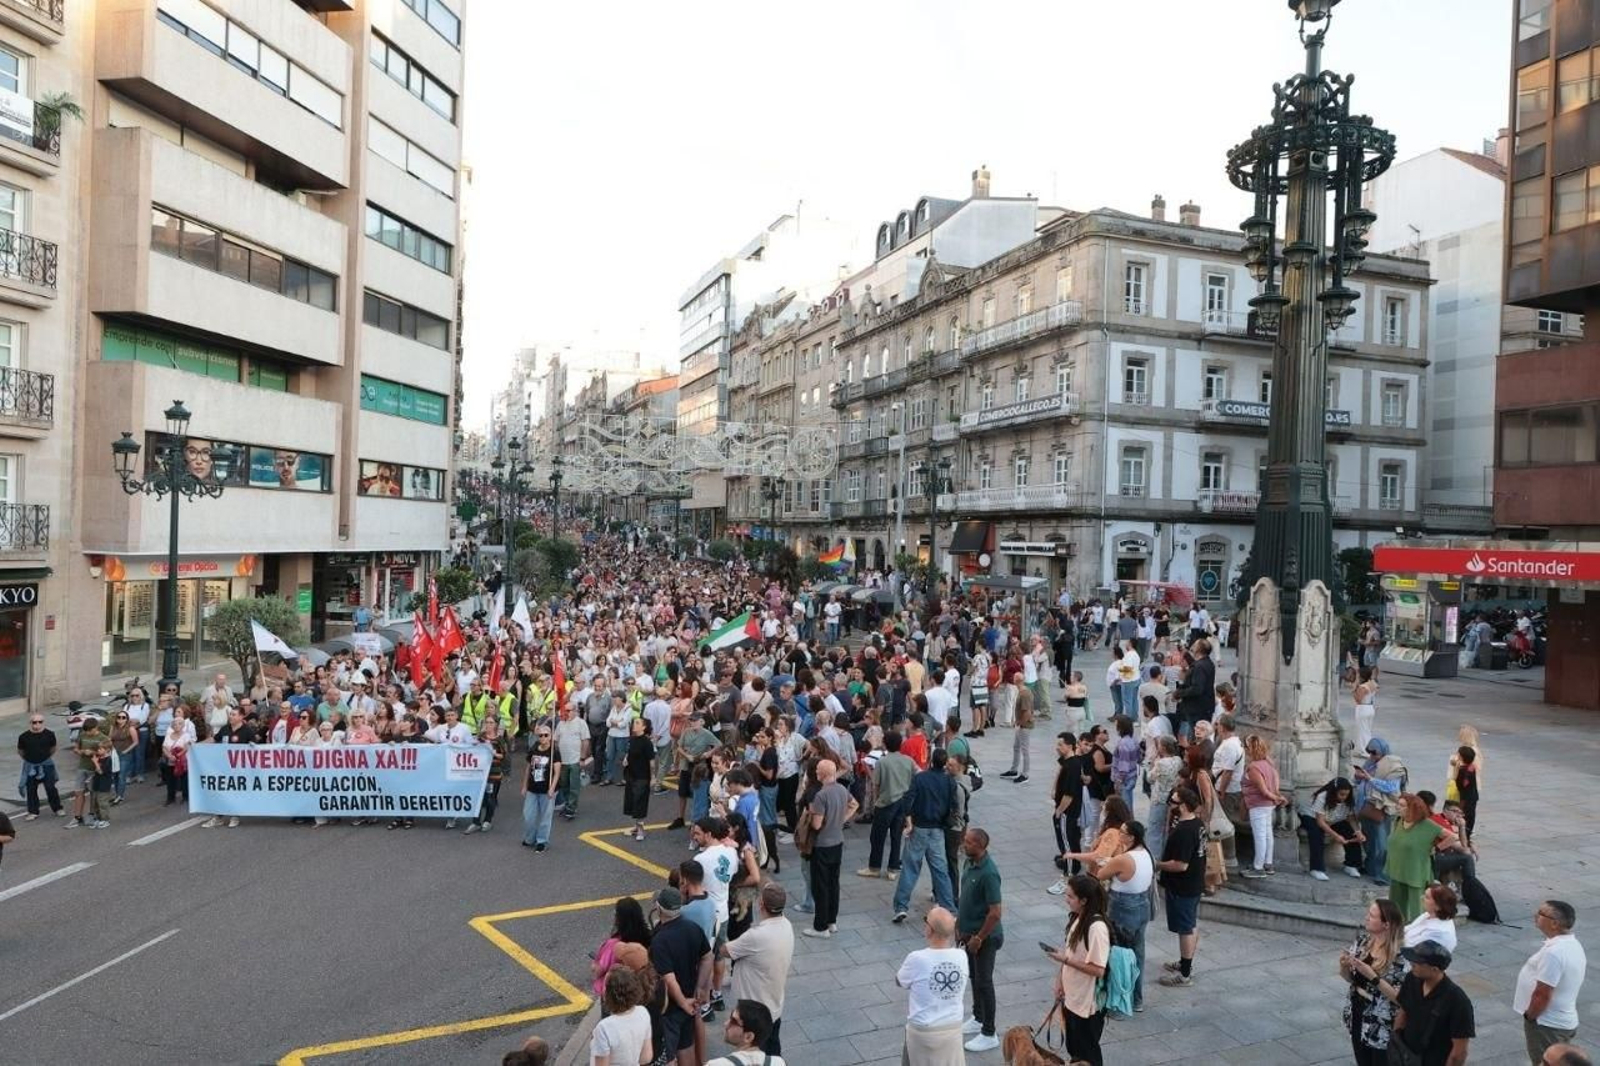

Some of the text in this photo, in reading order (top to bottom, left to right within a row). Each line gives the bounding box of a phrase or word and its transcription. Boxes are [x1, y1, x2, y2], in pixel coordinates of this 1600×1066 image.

[251, 464, 274, 472] POLICE
[1487, 557, 1575, 576] Santander
[227, 748, 418, 770] VIVENDA DIGNA XA!!!
[456, 752, 478, 768] CIG
[200, 772, 382, 793] FREAR A ESPECULACIÓN,
[319, 794, 472, 812] GARANTIR DEREITOS
